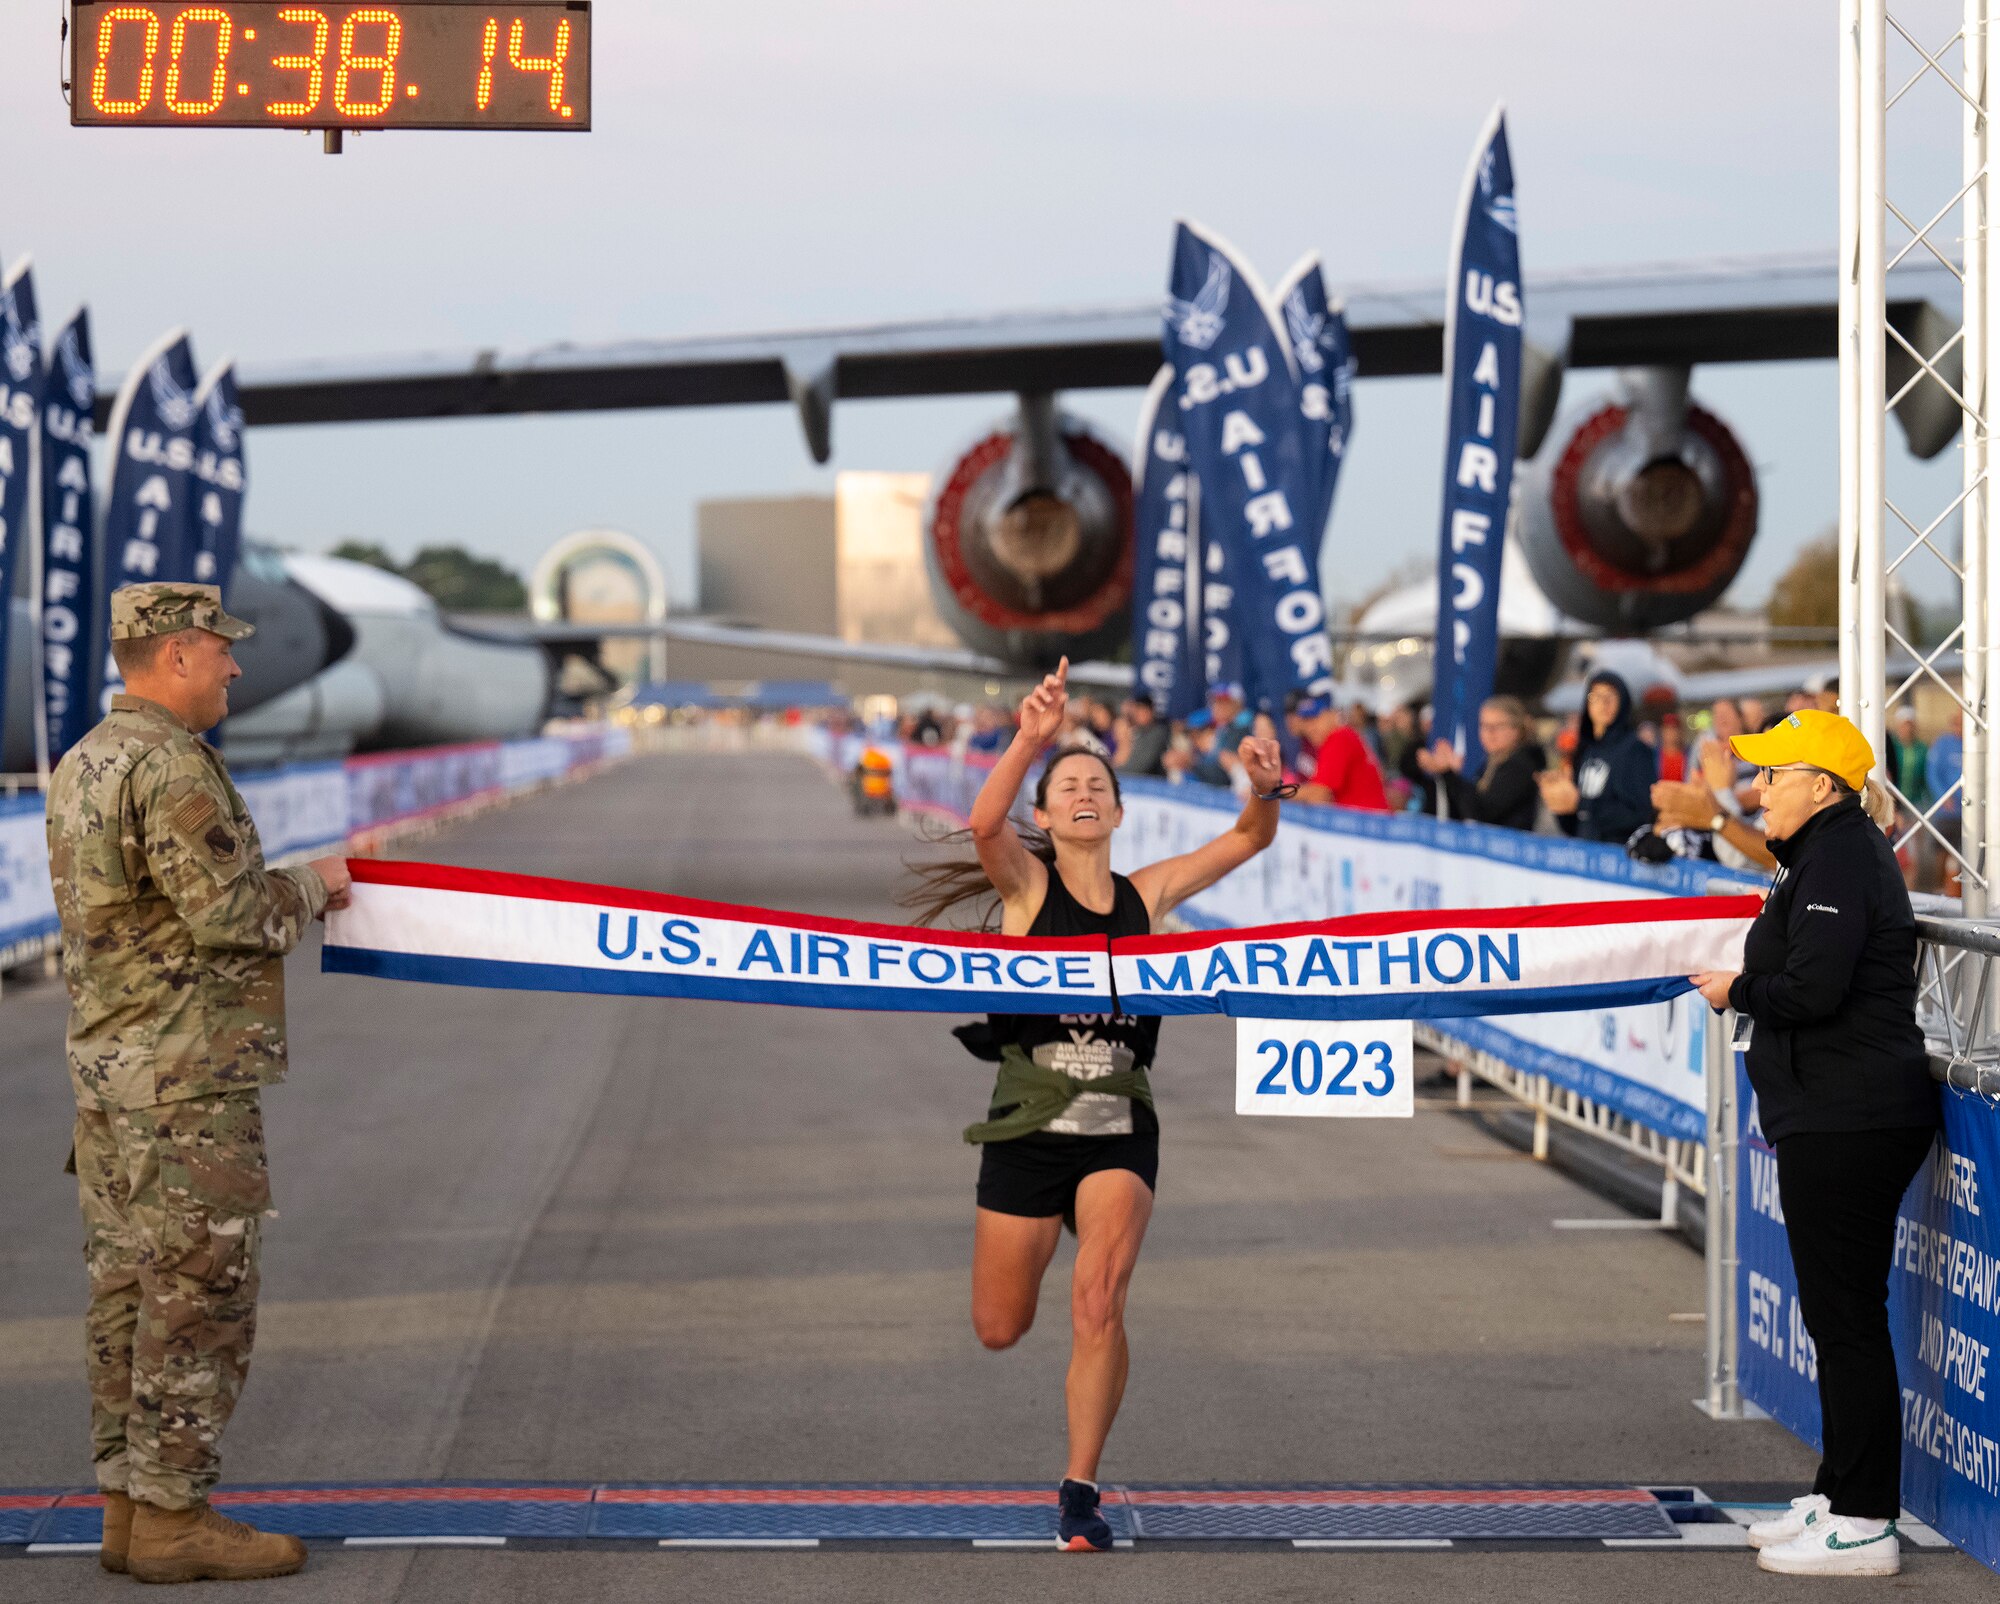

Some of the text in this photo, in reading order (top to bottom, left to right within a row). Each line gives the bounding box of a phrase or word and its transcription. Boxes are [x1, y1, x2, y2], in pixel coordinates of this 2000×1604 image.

[1456, 341, 1500, 492] AIR
[51, 454, 88, 563] AIR
[121, 474, 172, 577] AIR
[598, 912, 1521, 992] U.S. AIR FORCE MARATHON
[1811, 903, 1839, 914] Columbia
[1255, 1039, 1395, 1097] 2023
[1933, 1145, 1980, 1217] WHERE
[1748, 1270, 1783, 1360] EST.
[1917, 1310, 1990, 1402] AND PRIDE
[1901, 1387, 2000, 1498] TAKE FLIGHT!
